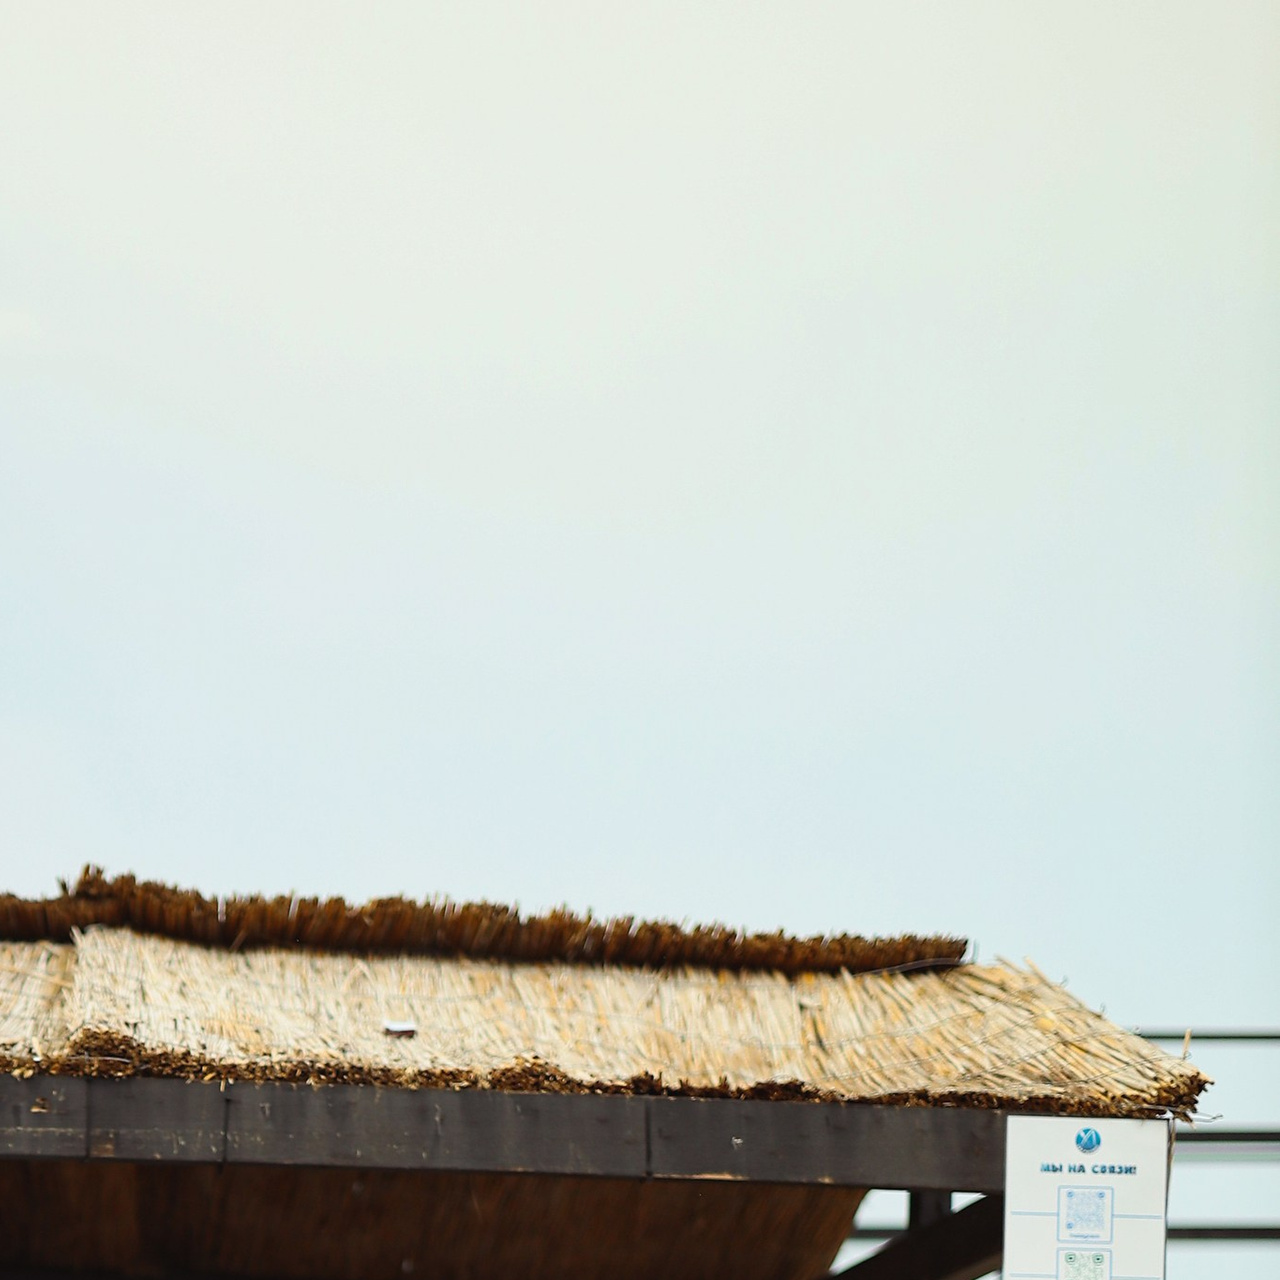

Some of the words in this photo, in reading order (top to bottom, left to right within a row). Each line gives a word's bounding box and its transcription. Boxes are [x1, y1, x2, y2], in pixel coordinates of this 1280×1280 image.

[1040, 1163, 1063, 1173] МЫ
[1068, 1164, 1086, 1174] НА
[1091, 1164, 1137, 1175] СВЯЗИ!
